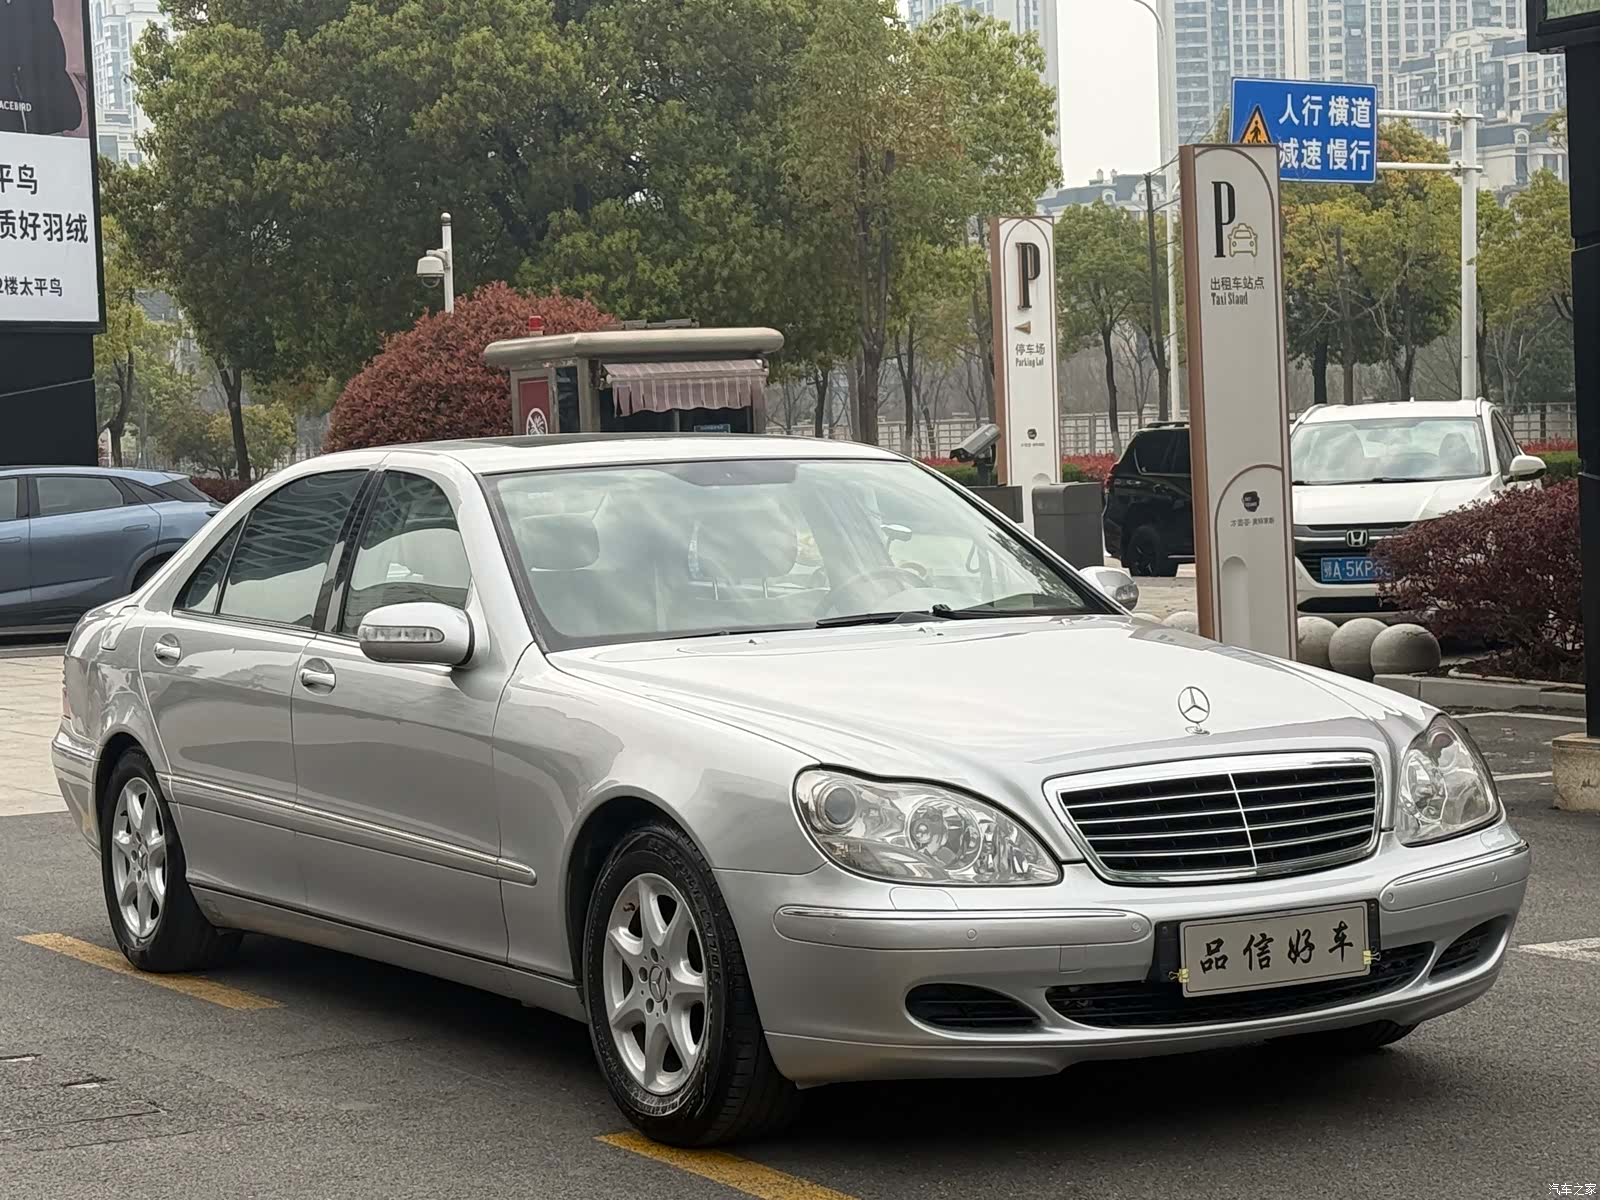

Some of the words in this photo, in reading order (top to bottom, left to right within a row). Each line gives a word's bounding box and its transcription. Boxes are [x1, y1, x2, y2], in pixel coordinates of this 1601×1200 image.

[1278, 93, 1372, 128] 人行横道
[1279, 137, 1371, 171] 减速慢行
[0, 209, 88, 243] 质好羽绒
[1211, 181, 1235, 258] P
[1015, 242, 1040, 311] P
[1210, 276, 1264, 291] 出租车站点
[1211, 292, 1227, 306] Taxi
[1015, 343, 1045, 356] 停车场
[1200, 921, 1353, 974] 品信好车
